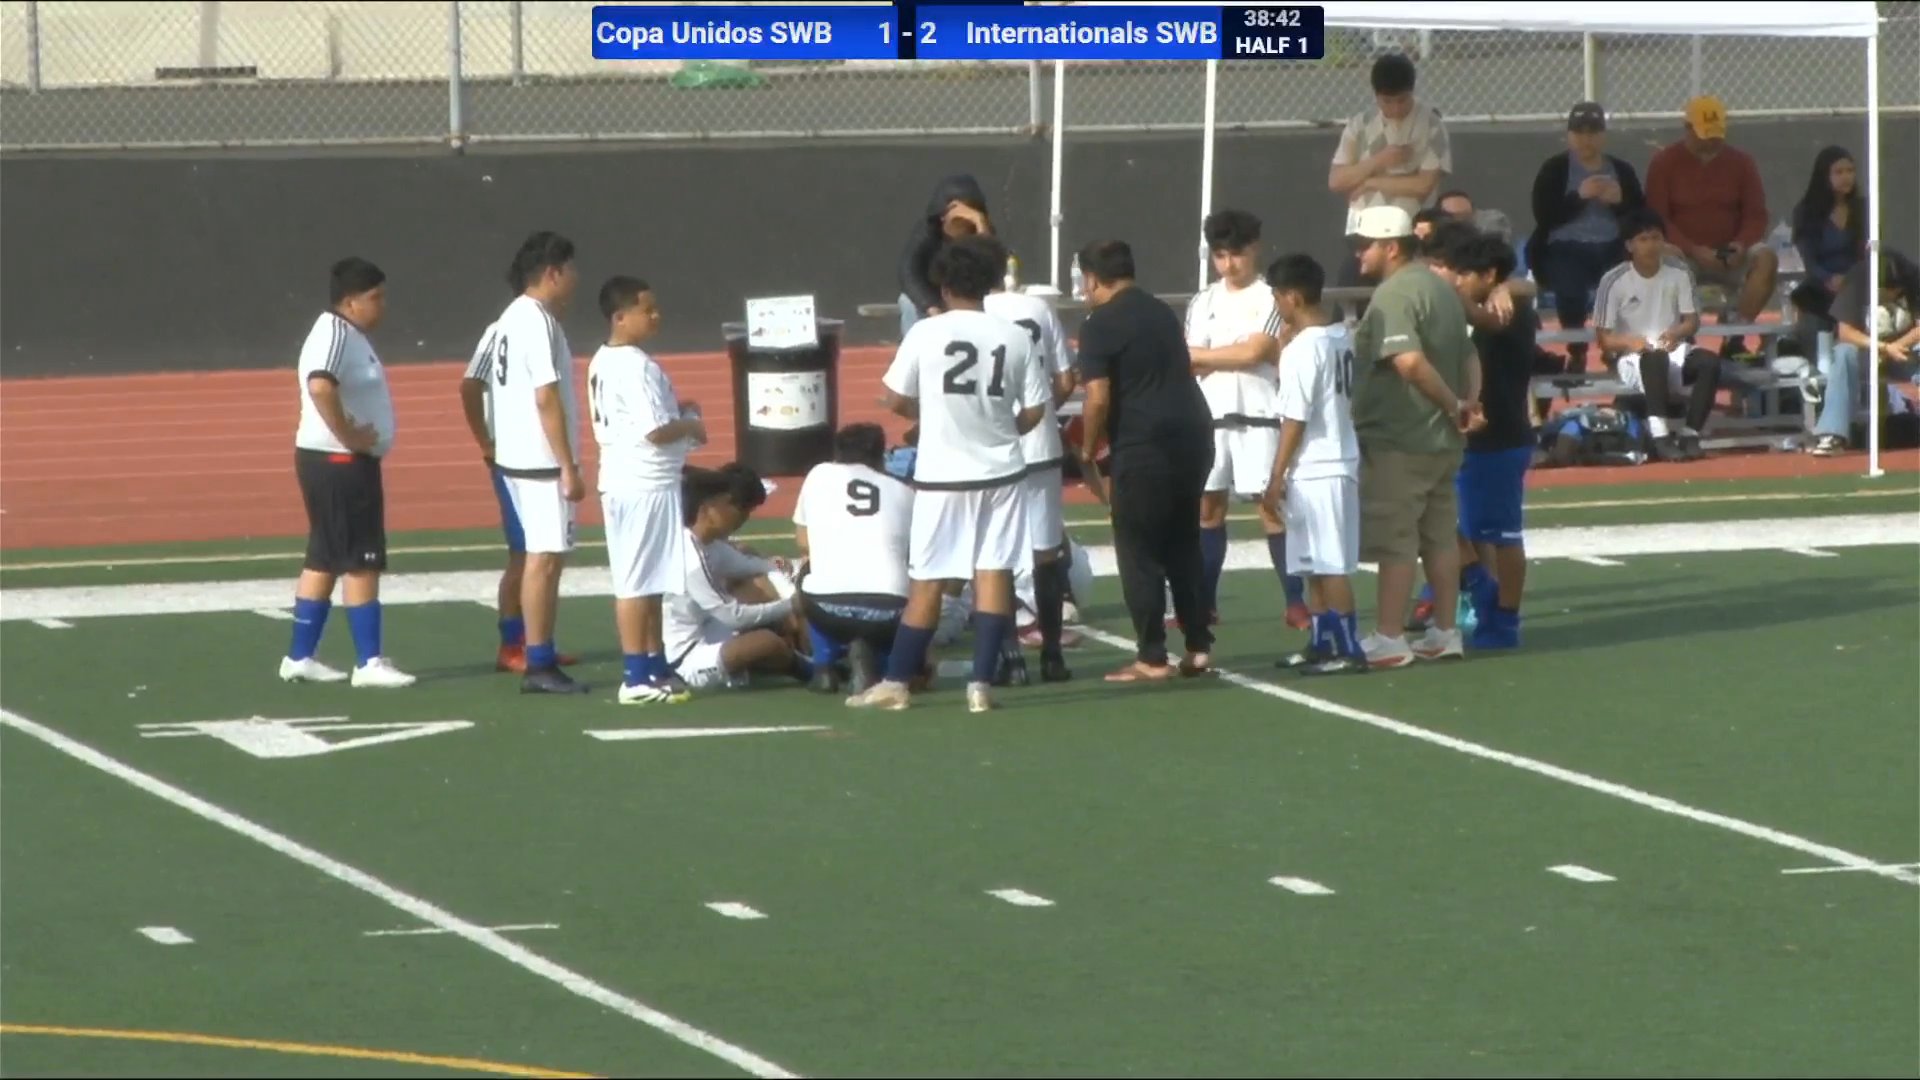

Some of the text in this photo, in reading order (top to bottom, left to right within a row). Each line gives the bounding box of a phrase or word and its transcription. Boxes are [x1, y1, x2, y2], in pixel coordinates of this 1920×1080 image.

[1702, 110, 1719, 123] LA
[943, 340, 1007, 397] 21
[846, 478, 880, 516] 9
